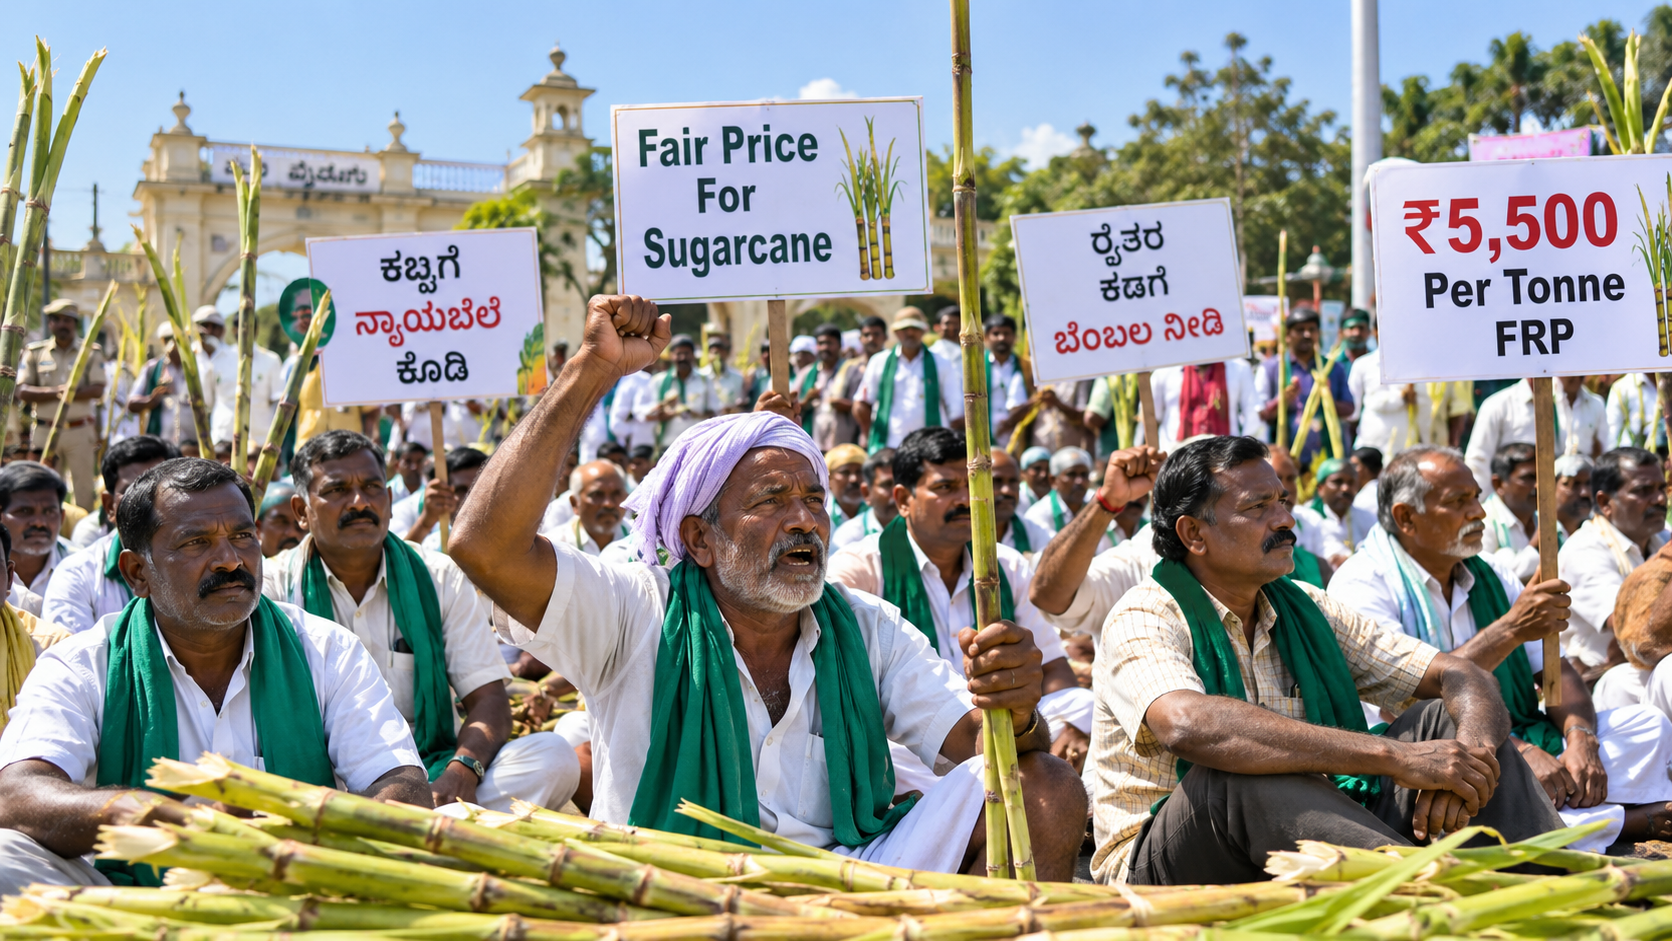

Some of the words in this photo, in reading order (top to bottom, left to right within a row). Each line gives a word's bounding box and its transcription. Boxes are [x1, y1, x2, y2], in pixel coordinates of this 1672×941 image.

[638, 126, 709, 168] Fair
[722, 123, 819, 165] Price
[697, 177, 757, 214] For
[1090, 220, 1166, 267] ರೈತರ
[1402, 191, 1618, 264] ₹5,500
[643, 227, 833, 278] Sugarcane
[1424, 272, 1492, 309] Per
[1502, 268, 1626, 305] Tonne
[355, 296, 502, 348] ನ್ಯಾಯಬೆಲೆ
[1054, 321, 1153, 355] ಬೆಂಬಲ
[1164, 307, 1224, 342] ನೀಡಿ
[1495, 318, 1575, 357] FRP
[396, 350, 469, 385] ಕೊಡಿ
